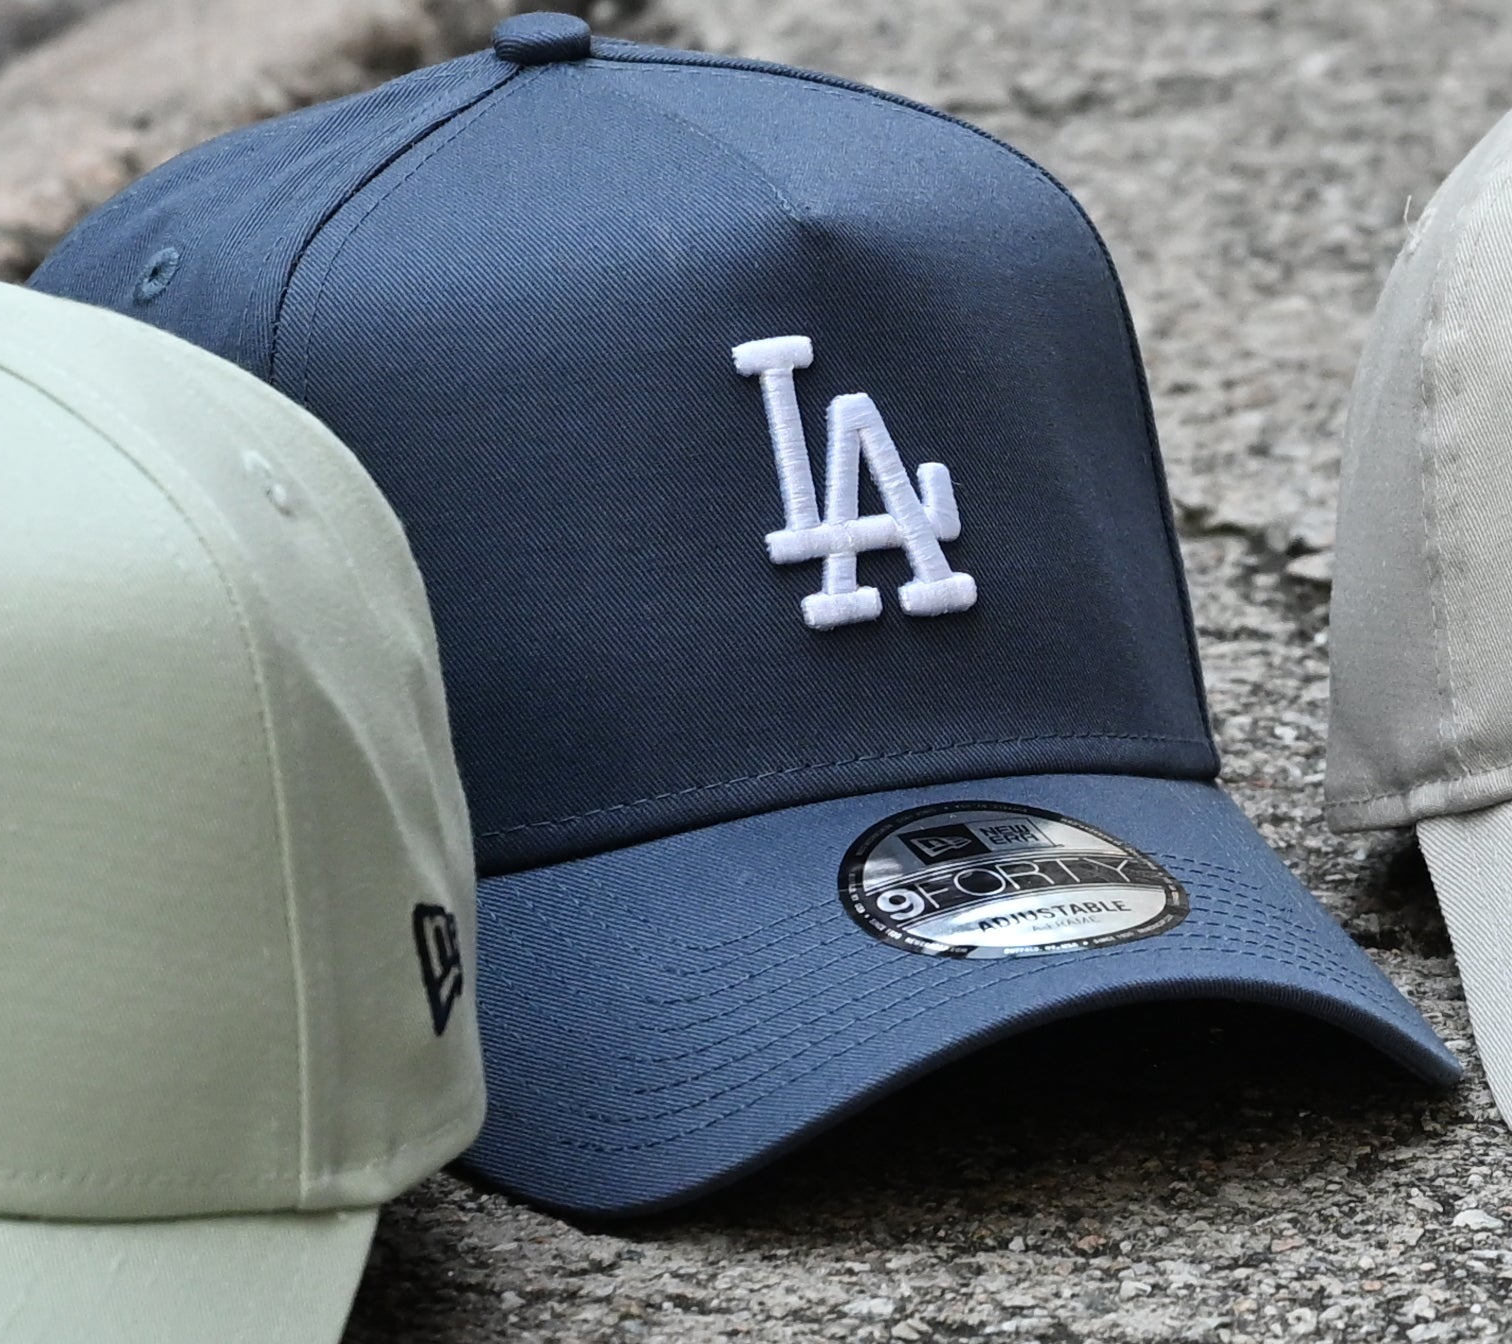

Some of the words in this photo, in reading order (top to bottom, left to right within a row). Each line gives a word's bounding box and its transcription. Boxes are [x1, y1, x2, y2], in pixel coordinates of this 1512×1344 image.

[732, 335, 978, 630] LA
[979, 823, 1031, 837] NEW
[987, 832, 1040, 845] ERA
[876, 857, 1132, 921] 9FORTY
[978, 900, 1132, 933] ADJUSTABLE
